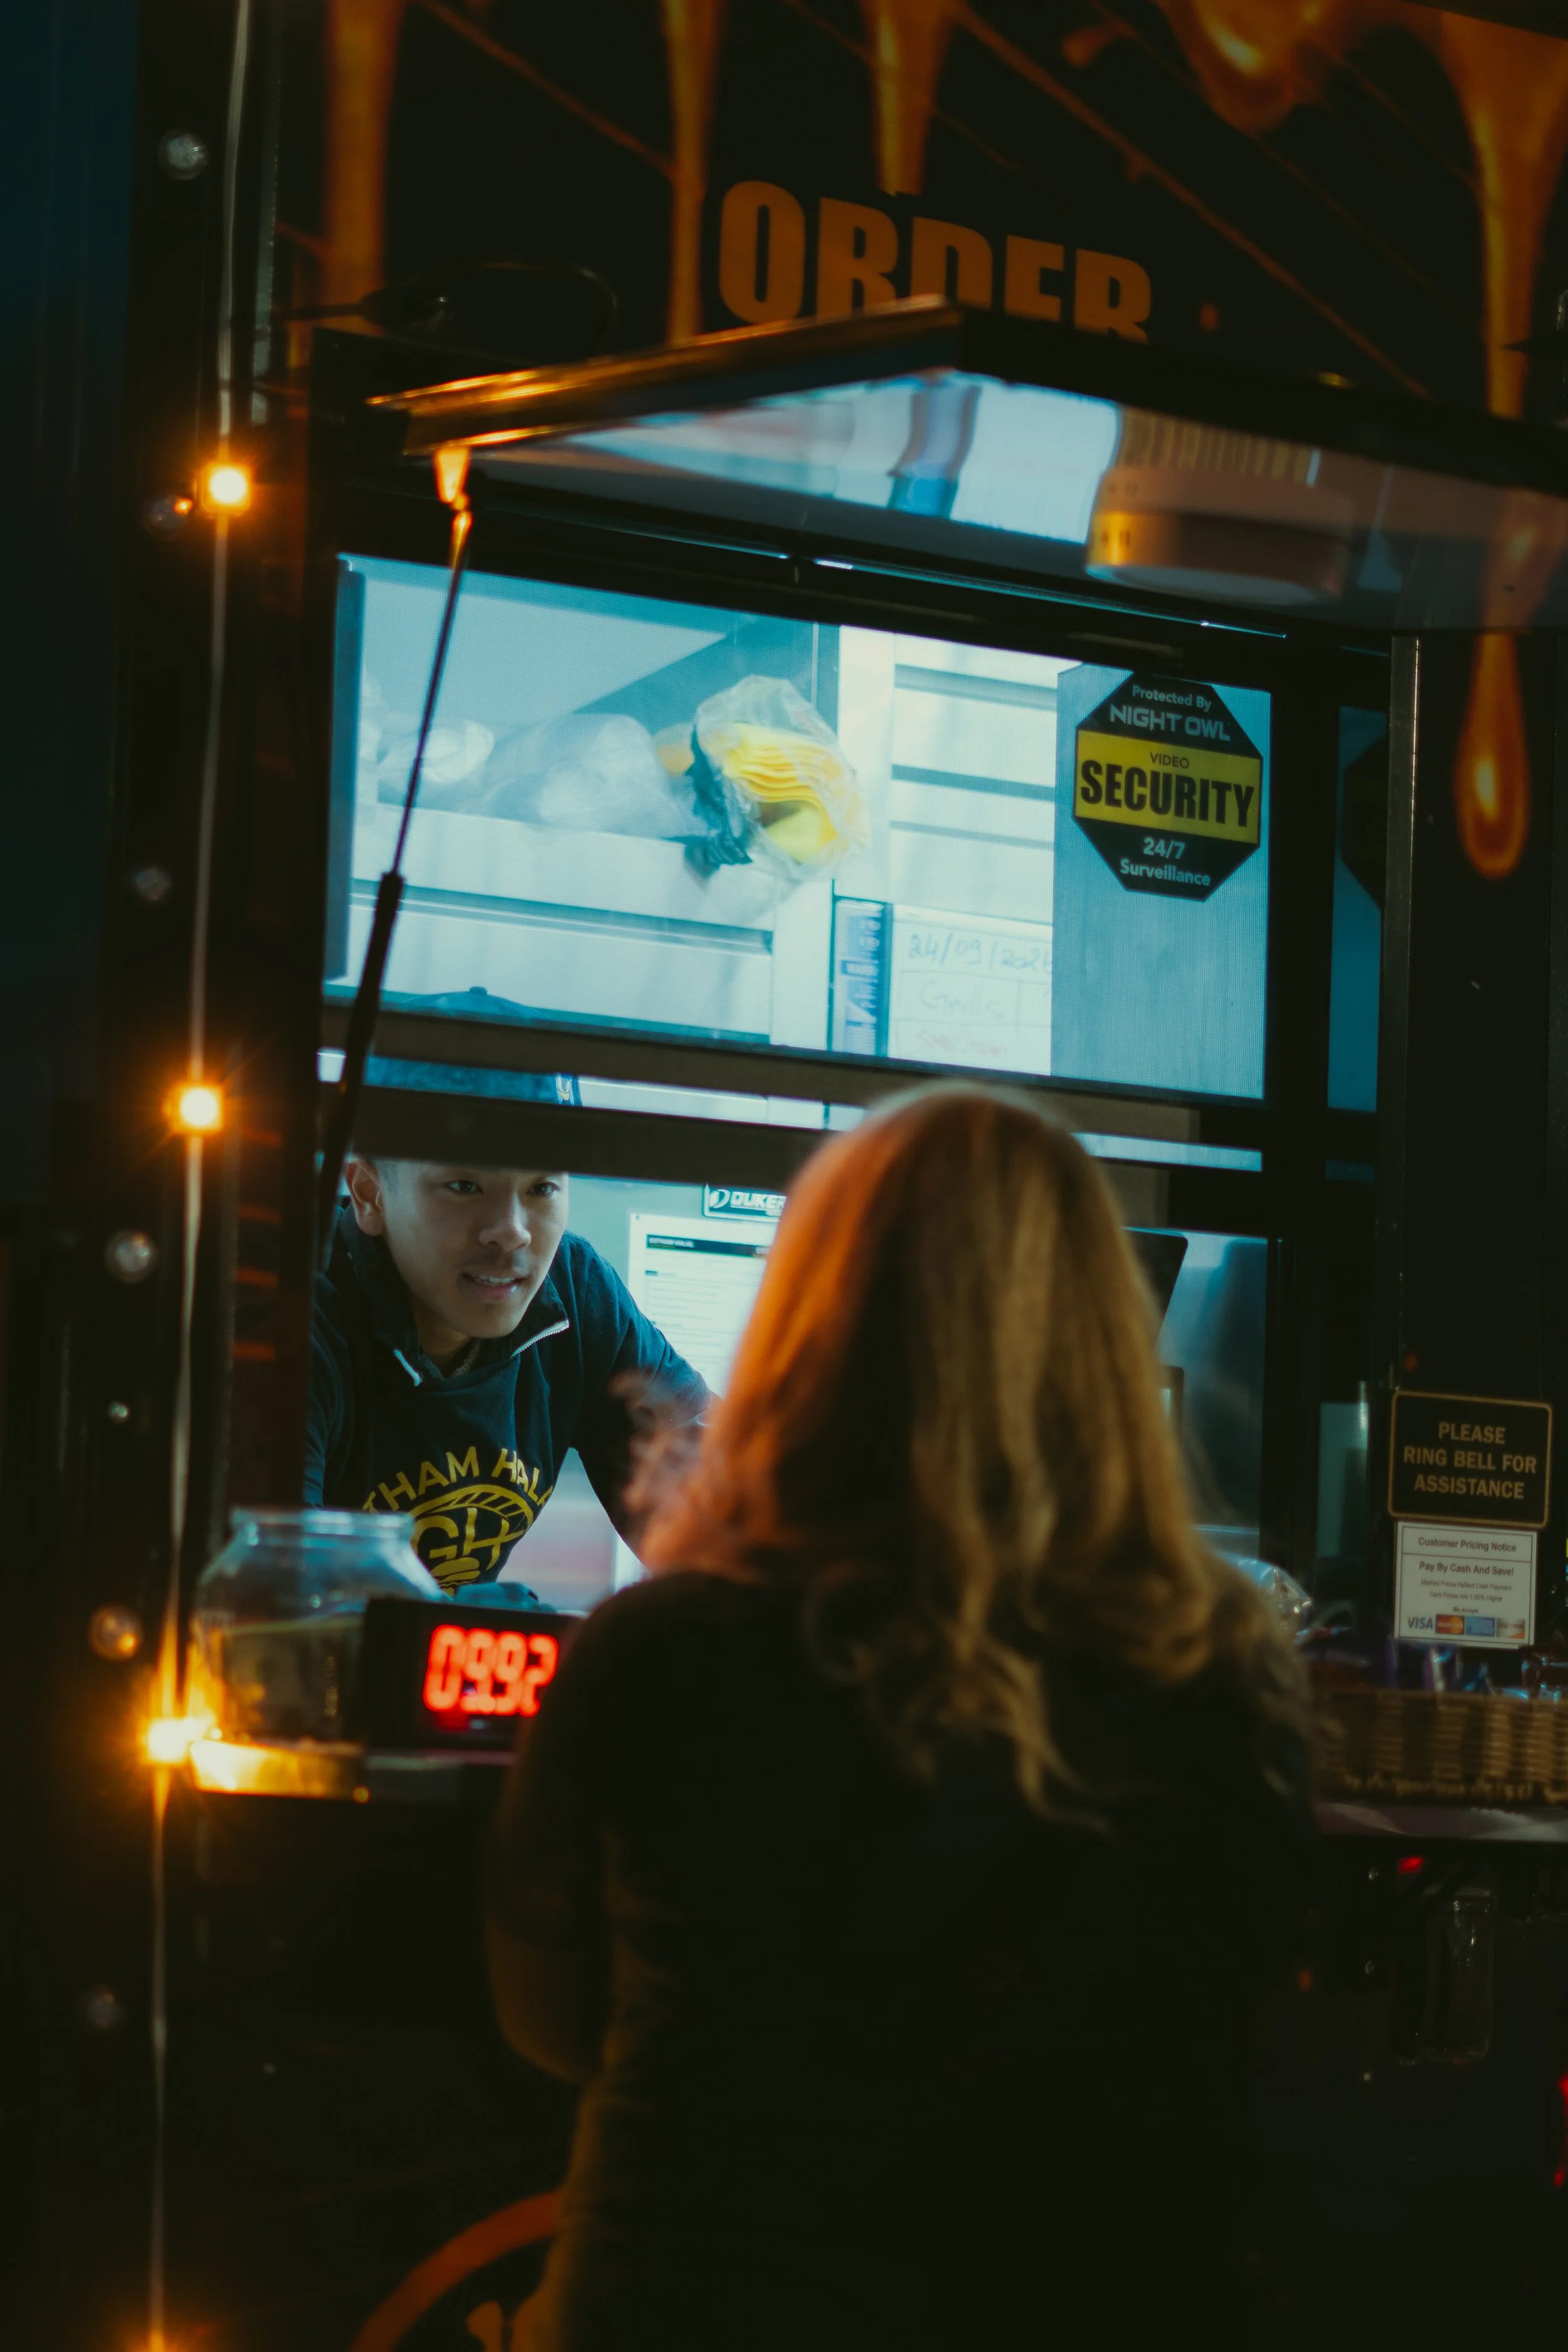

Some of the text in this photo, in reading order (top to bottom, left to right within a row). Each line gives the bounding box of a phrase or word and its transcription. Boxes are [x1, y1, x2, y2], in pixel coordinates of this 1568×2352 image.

[719, 180, 1152, 344] ORDER
[1132, 685, 1212, 712] Protected By
[1110, 704, 1231, 741] NIGHT OWL
[1150, 753, 1189, 769] VIDEO
[1080, 760, 1254, 828] SECURITY
[1143, 837, 1185, 859] 24/7
[1120, 859, 1211, 886] Surveillance
[1438, 1422, 1506, 1444] PLEASE
[1403, 1446, 1537, 1473] RING BELL FOR
[1414, 1474, 1525, 1499] ASSISTANCE
[1418, 1537, 1517, 1552] Customer Pricing Notice
[1419, 1561, 1514, 1576] Pay By Cash And Save!
[1407, 1616, 1434, 1629] VISA
